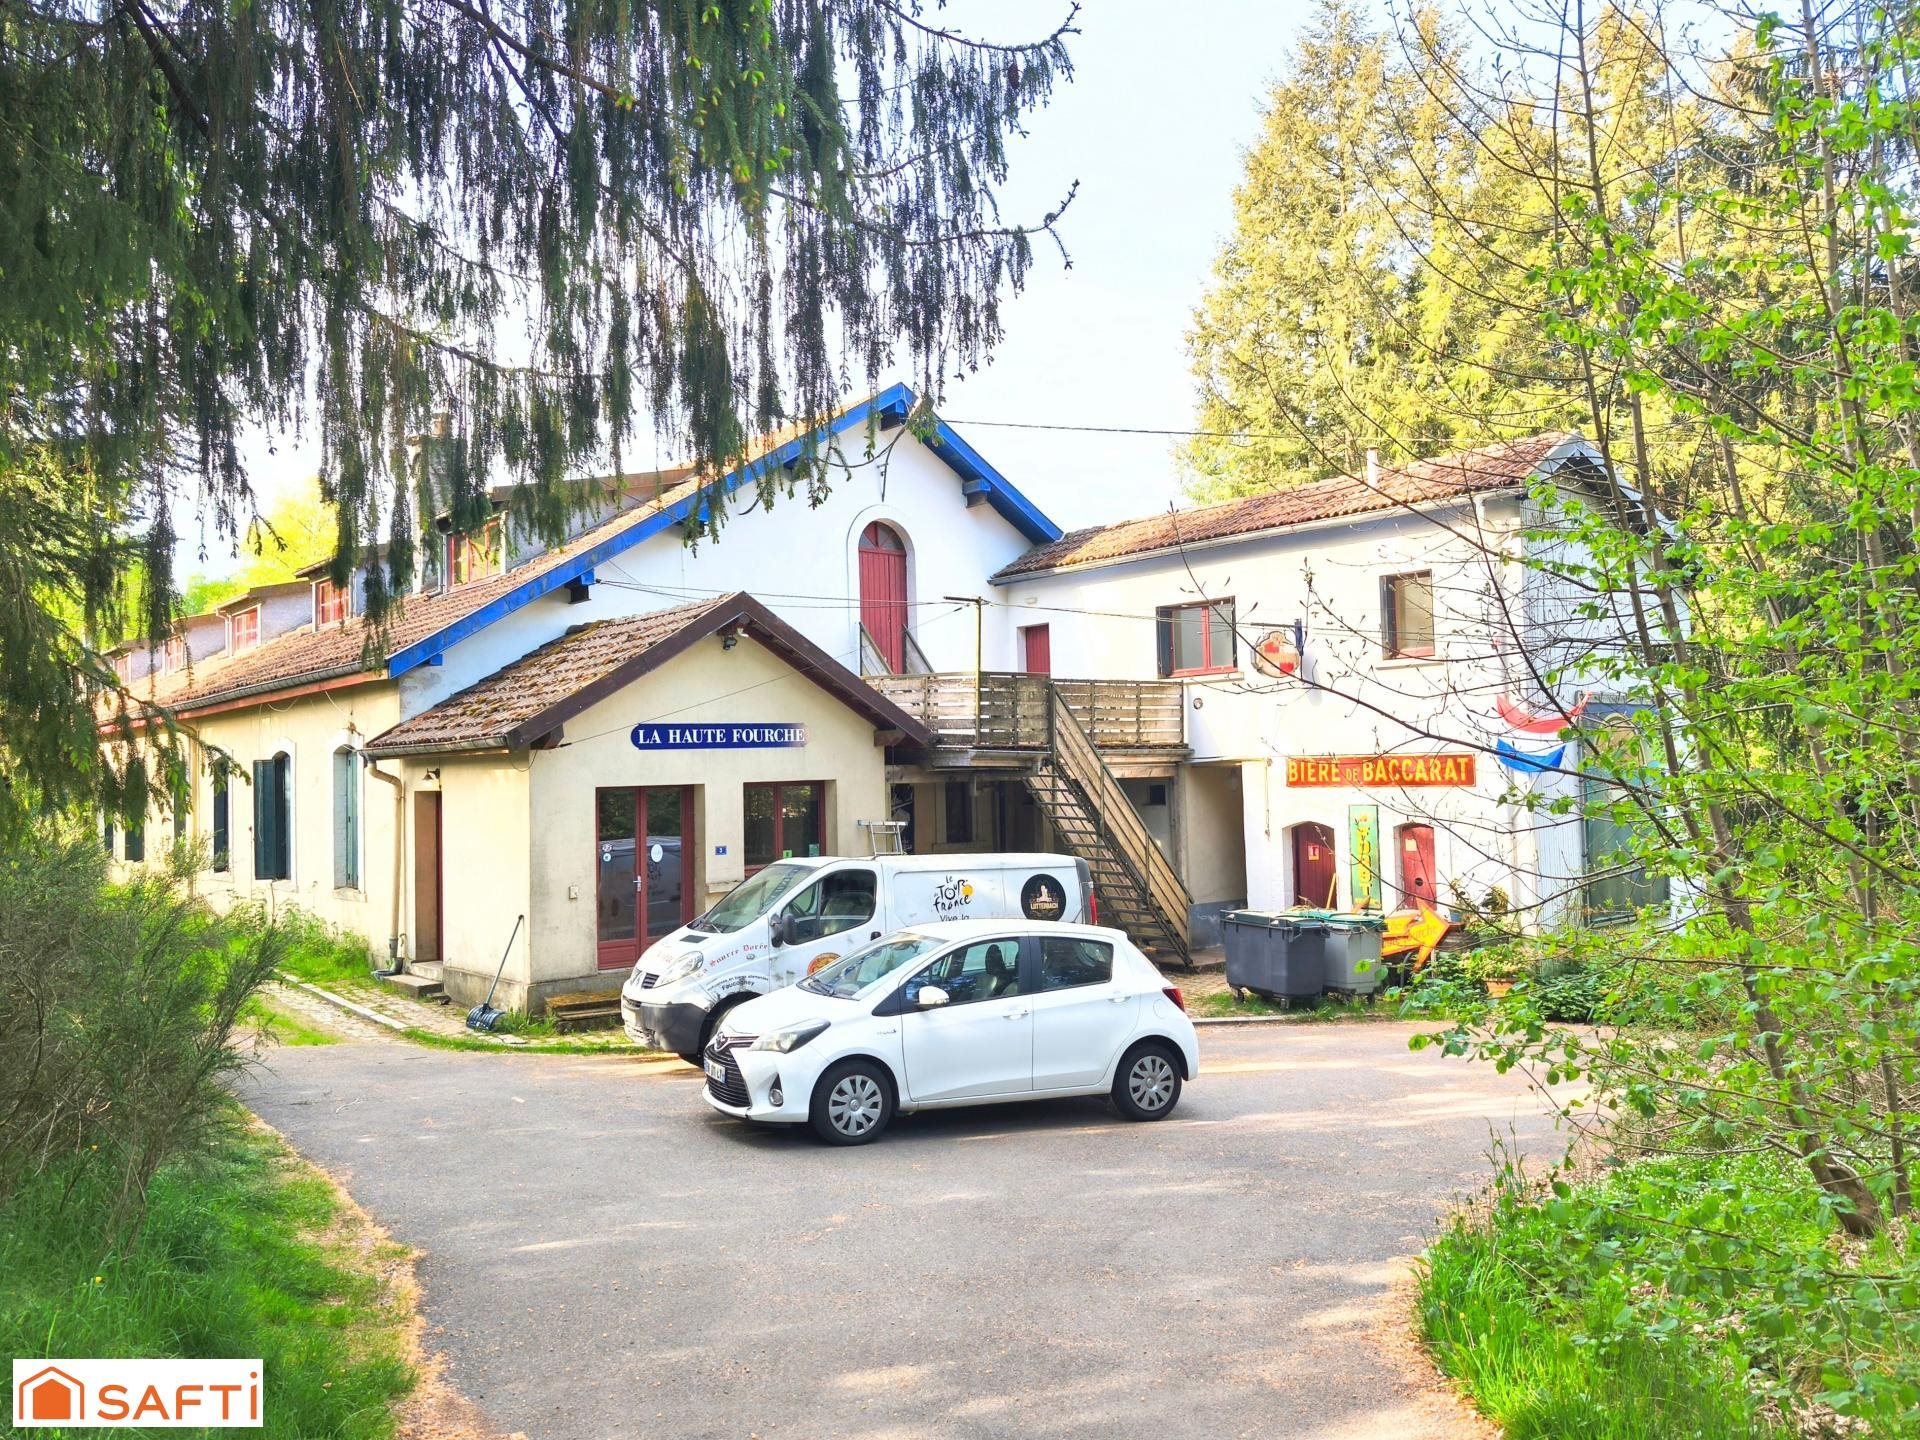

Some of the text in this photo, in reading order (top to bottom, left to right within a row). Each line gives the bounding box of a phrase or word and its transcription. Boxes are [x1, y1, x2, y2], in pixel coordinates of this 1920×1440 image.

[638, 728, 805, 744] LA HAUTE FOURCHE
[1287, 757, 1342, 783] BIÈRE
[1362, 757, 1470, 783] BACCARAT
